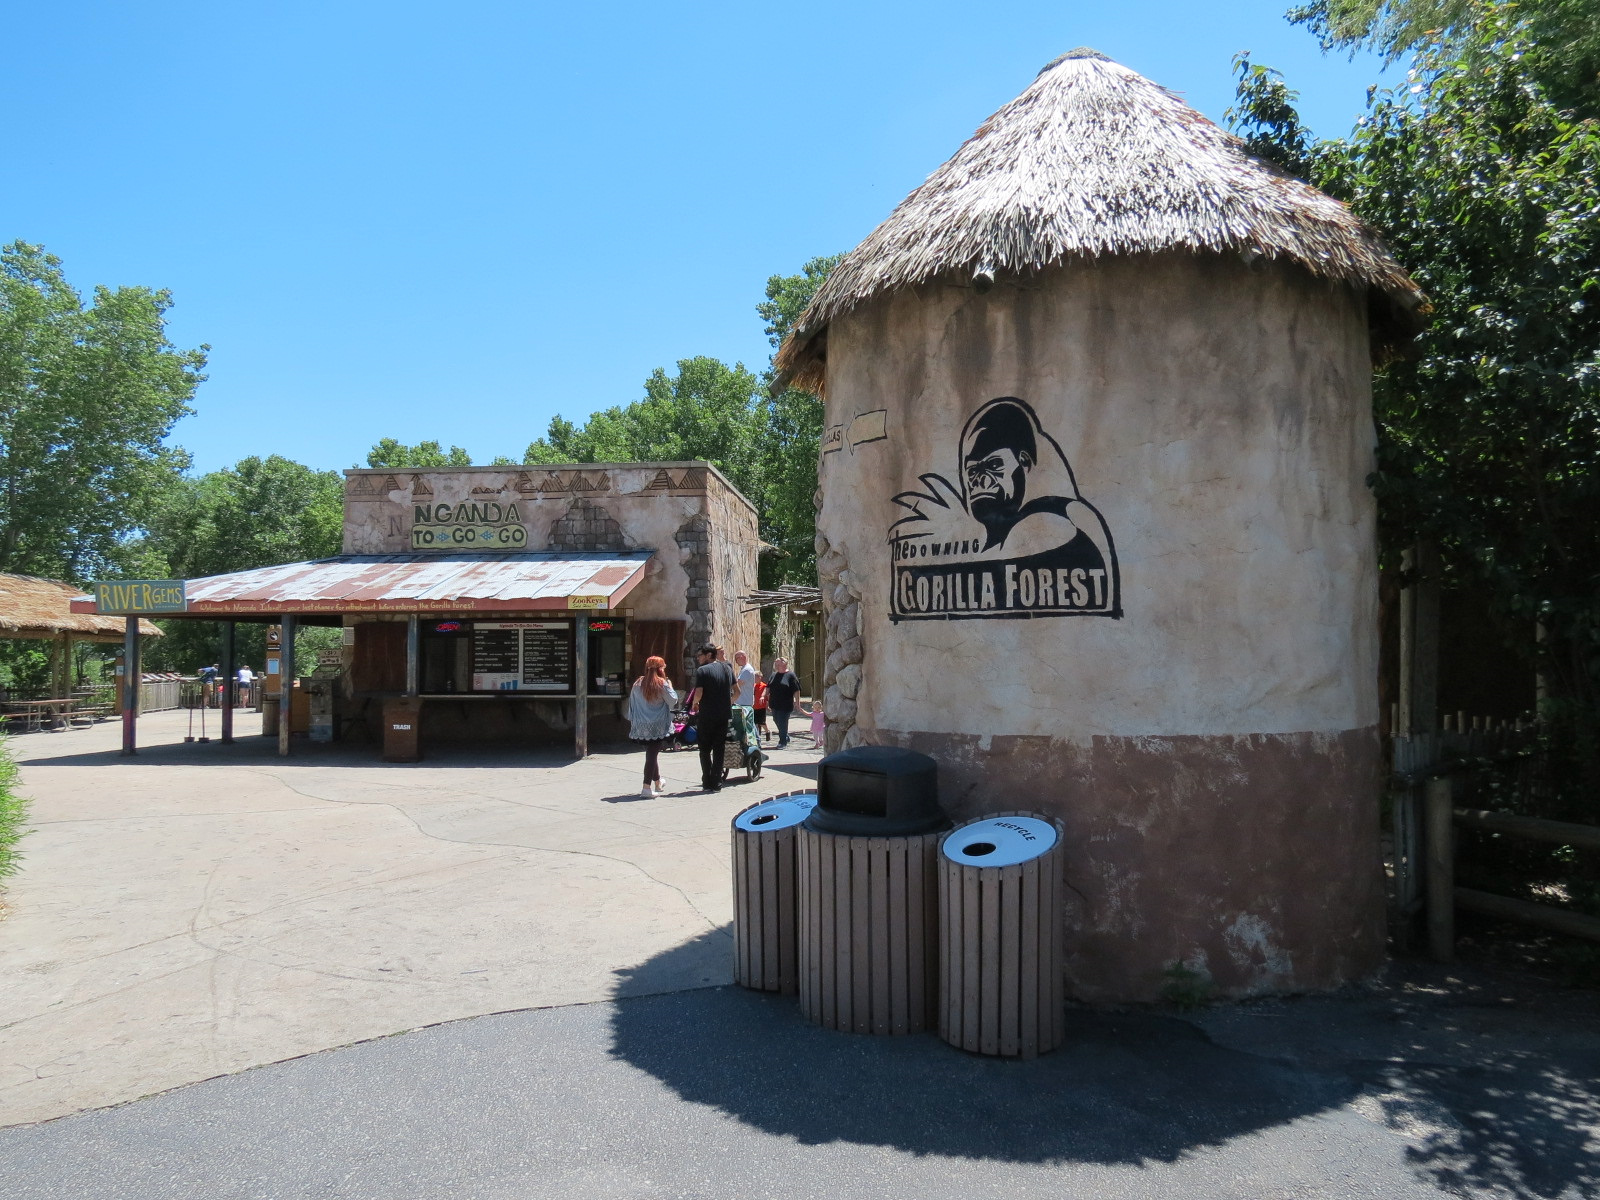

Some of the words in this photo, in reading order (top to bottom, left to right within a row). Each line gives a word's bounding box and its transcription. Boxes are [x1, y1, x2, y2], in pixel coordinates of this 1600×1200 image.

[414, 503, 520, 523] NGANDA
[414, 530, 435, 544] TO
[452, 528, 476, 543] GO
[498, 528, 525, 543] GO
[910, 538, 981, 559] DOWNING
[100, 583, 153, 610] RIVER
[152, 587, 183, 605] GEMS
[900, 570, 996, 612] GORILLA
[1005, 564, 1105, 608] FOREST
[430, 600, 450, 609] Gorilla
[994, 822, 1036, 841] RECYCLE
